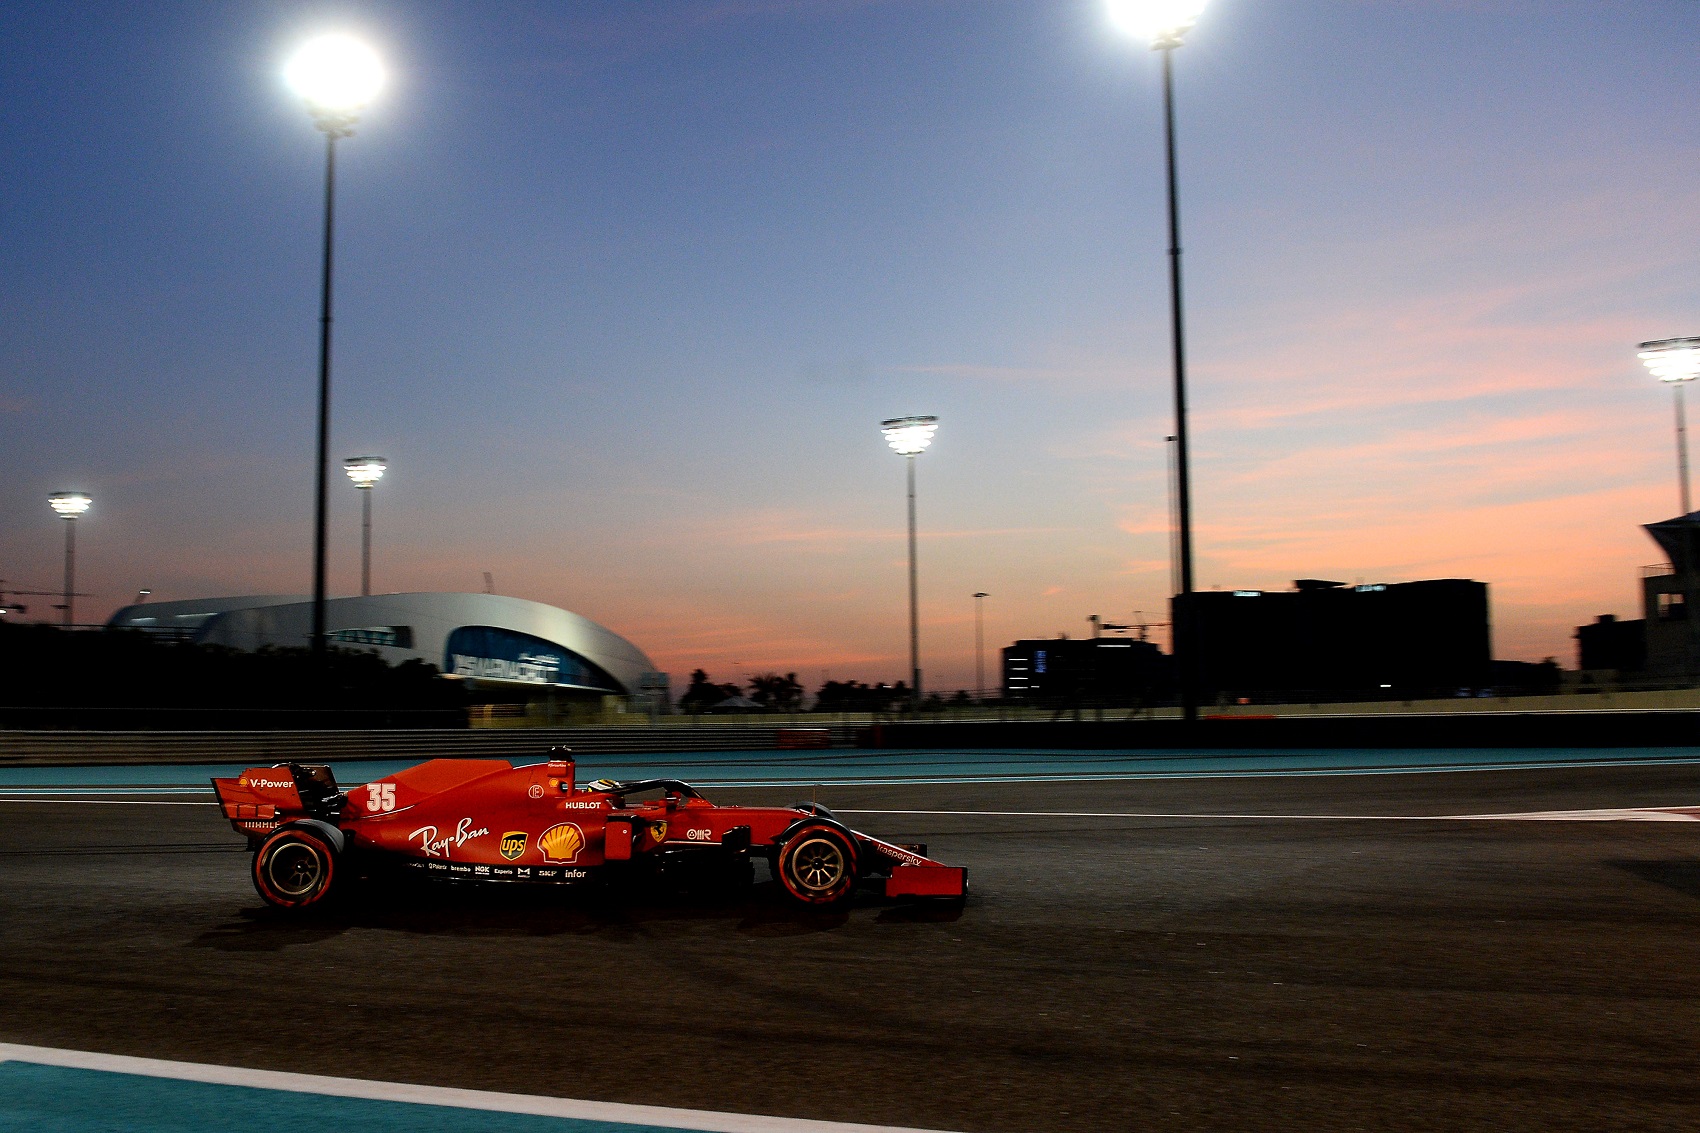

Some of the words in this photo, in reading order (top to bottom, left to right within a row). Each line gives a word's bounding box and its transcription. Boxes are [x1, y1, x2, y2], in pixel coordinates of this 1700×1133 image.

[250, 779, 294, 788] V-Power
[366, 783, 396, 812] 35
[876, 844, 922, 867] kaspersky
[450, 865, 471, 873] brembo
[564, 869, 587, 878] infor
